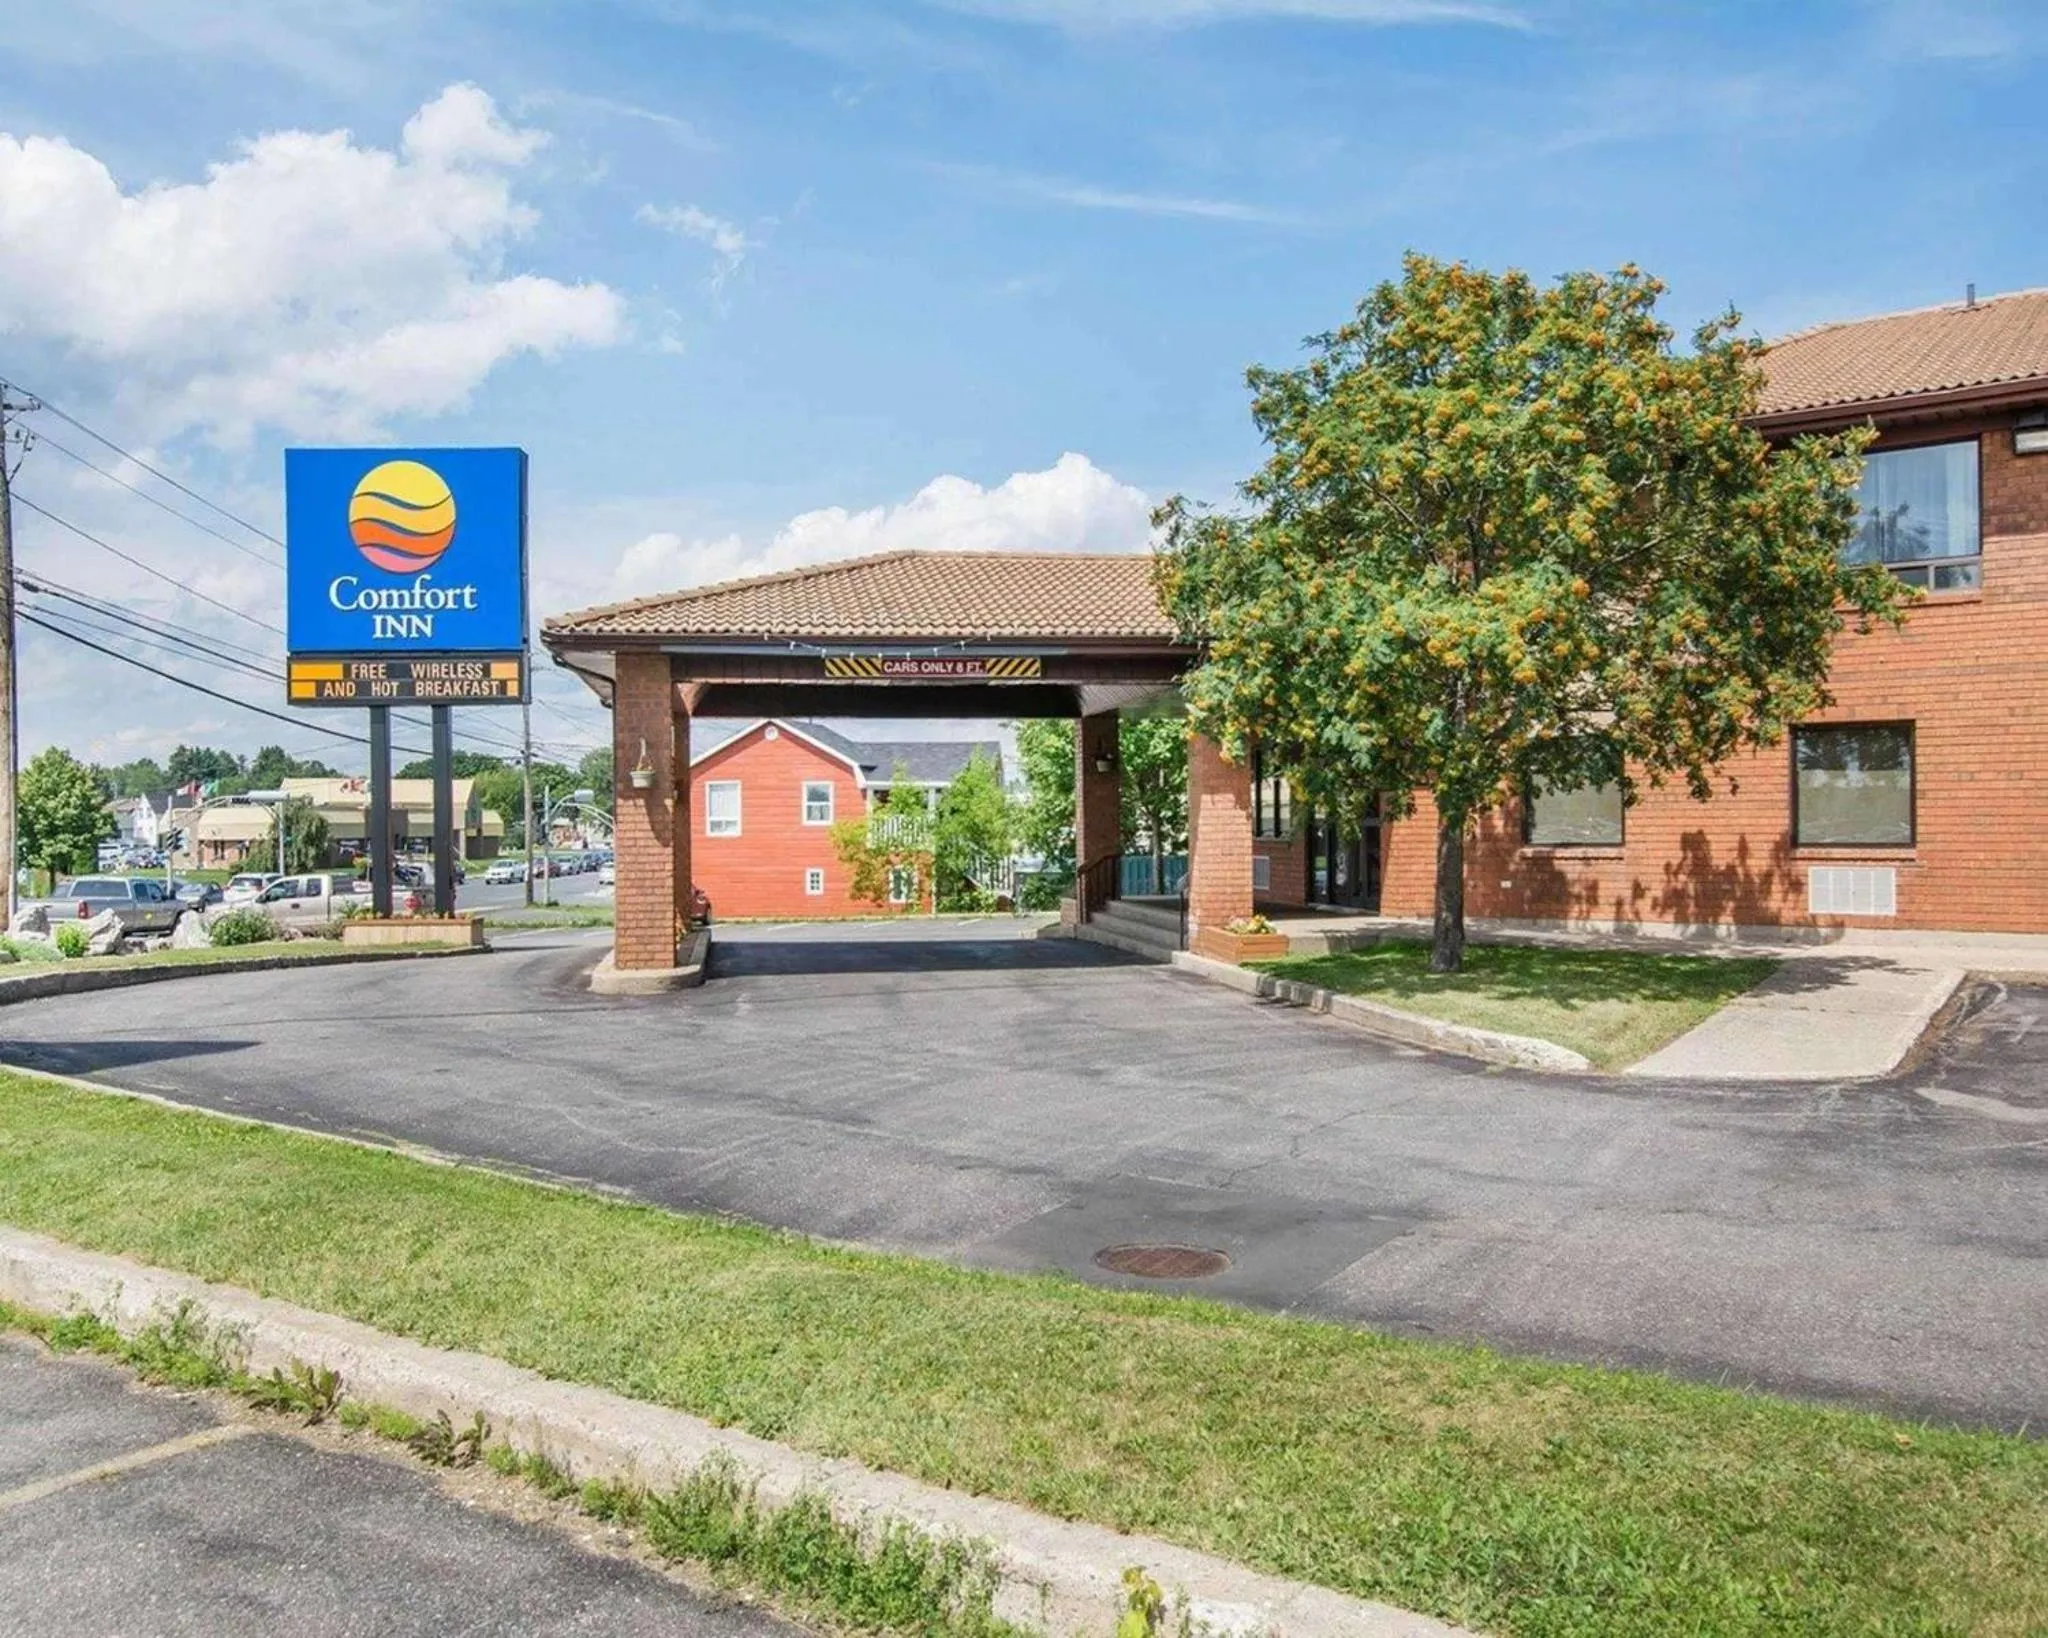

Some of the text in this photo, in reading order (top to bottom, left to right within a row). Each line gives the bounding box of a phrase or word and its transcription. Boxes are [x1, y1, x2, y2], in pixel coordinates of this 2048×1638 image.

[329, 574, 477, 610] Comfort
[373, 614, 434, 638] INN
[351, 663, 484, 680] FREE WIRELESS
[884, 661, 918, 673] CARS
[921, 661, 954, 673] ONLY
[966, 661, 984, 673] FT.
[323, 681, 500, 697] AND HOT BREAKFAST
